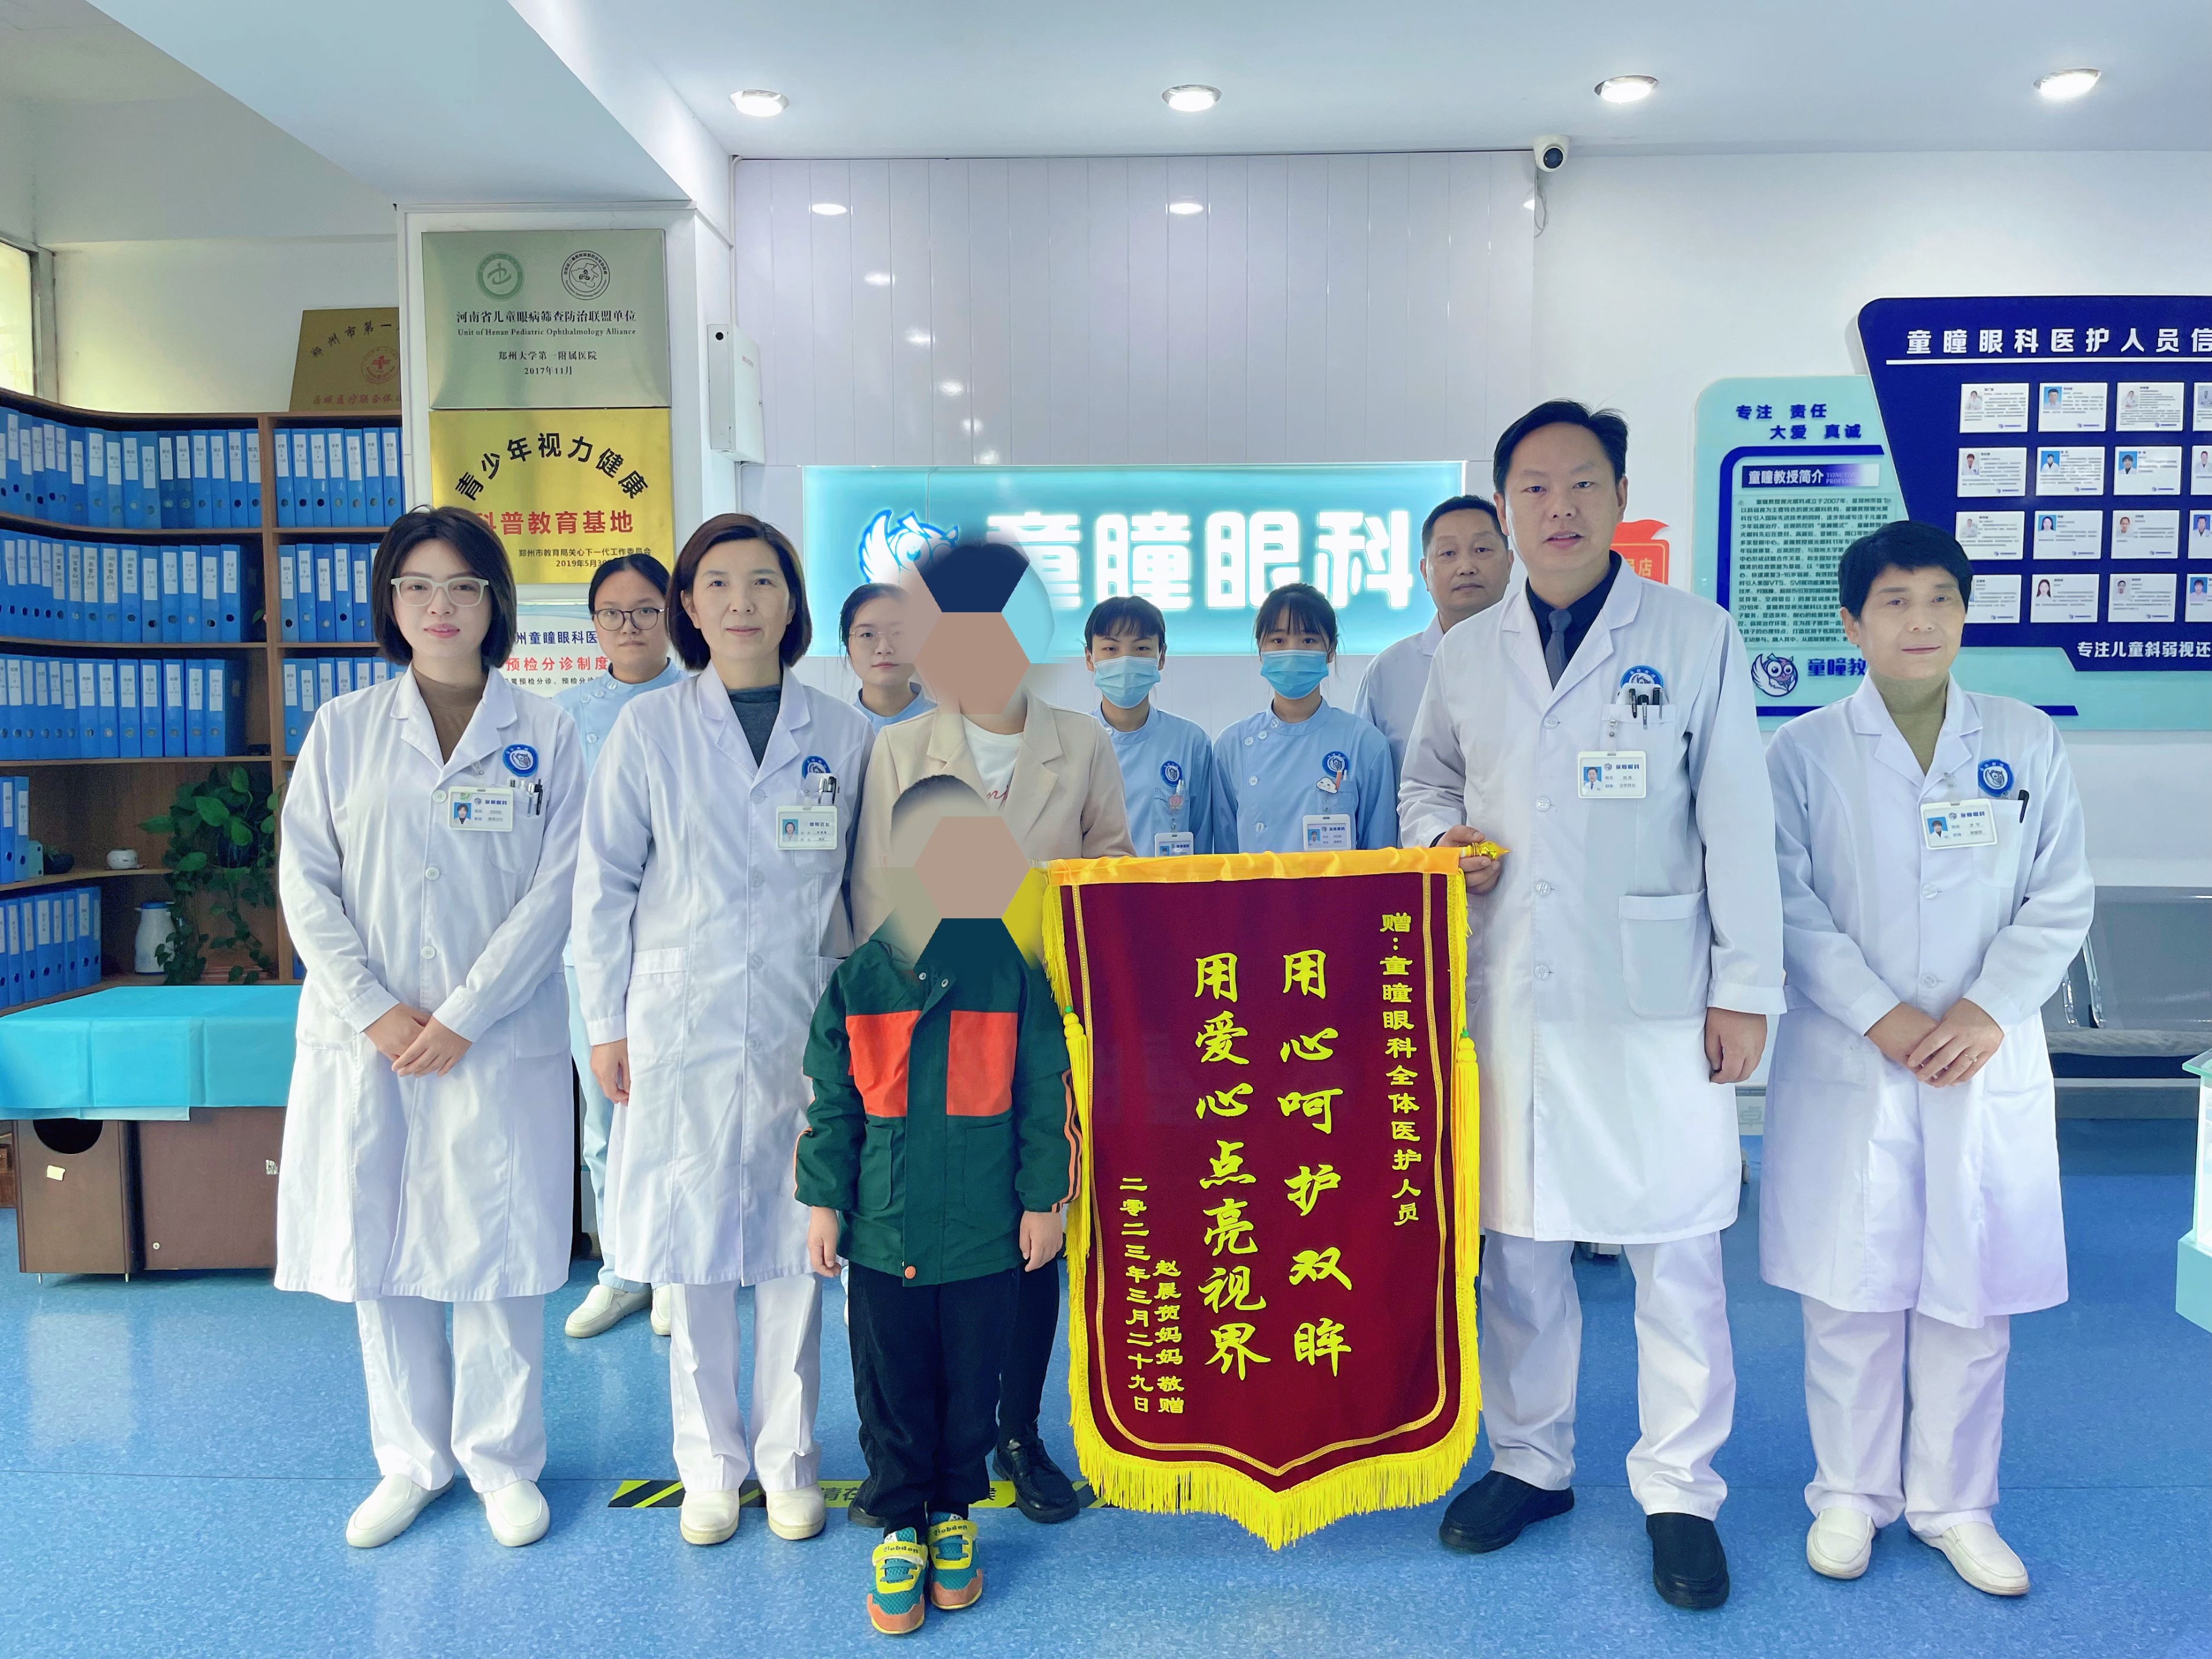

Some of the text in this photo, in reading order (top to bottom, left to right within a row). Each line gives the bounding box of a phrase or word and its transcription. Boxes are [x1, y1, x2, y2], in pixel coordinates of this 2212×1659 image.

[456, 310, 637, 323] 河南省儿童眼病筛查防治联盟单位
[476, 328, 484, 336] of
[547, 328, 603, 337] Ophthalmology
[1906, 327, 2212, 354] 童瞳眼科医护人员信
[524, 366, 572, 376] 2017年11月
[1736, 404, 1827, 419] 专注 责任
[1769, 424, 1862, 440] 大爱 真诚
[455, 432, 648, 501] 青少年视力健康
[1748, 469, 1824, 485] 童瞳教授简介
[506, 656, 608, 672] 预检分诊制度
[1380, 912, 1422, 1227] 赠：童瞳眼科全体医护人员
[1195, 952, 1271, 1381] 用爱心点亮视界
[1277, 949, 1353, 1377] 用心呵护双眸
[1119, 1177, 1154, 1413] 二零二三年三月二十九日
